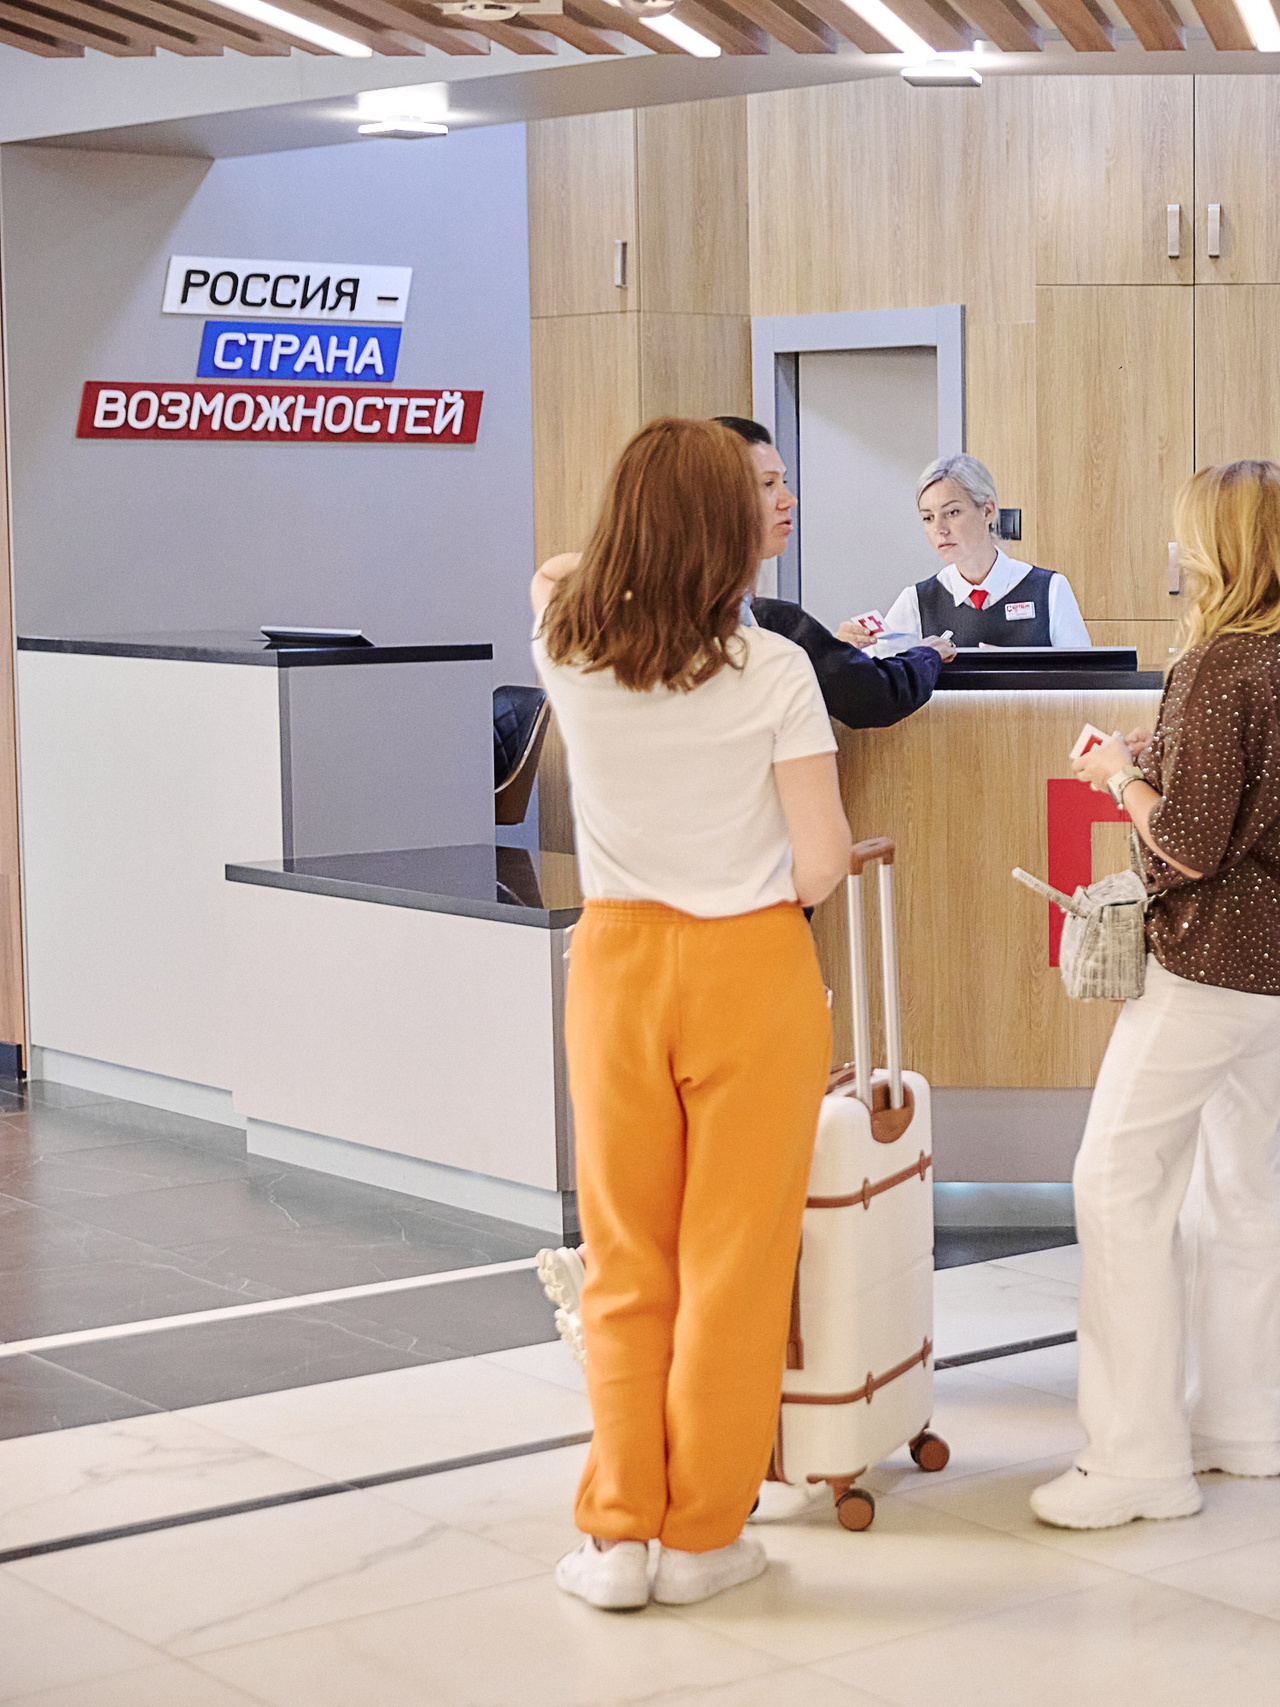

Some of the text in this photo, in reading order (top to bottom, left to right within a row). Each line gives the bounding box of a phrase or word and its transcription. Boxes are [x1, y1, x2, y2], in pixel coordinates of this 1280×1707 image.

[180, 269, 360, 311] РОССИЯ
[213, 331, 384, 375] СТРАНА
[93, 390, 465, 436] ВОЗМОЖНОСТЕЙ
